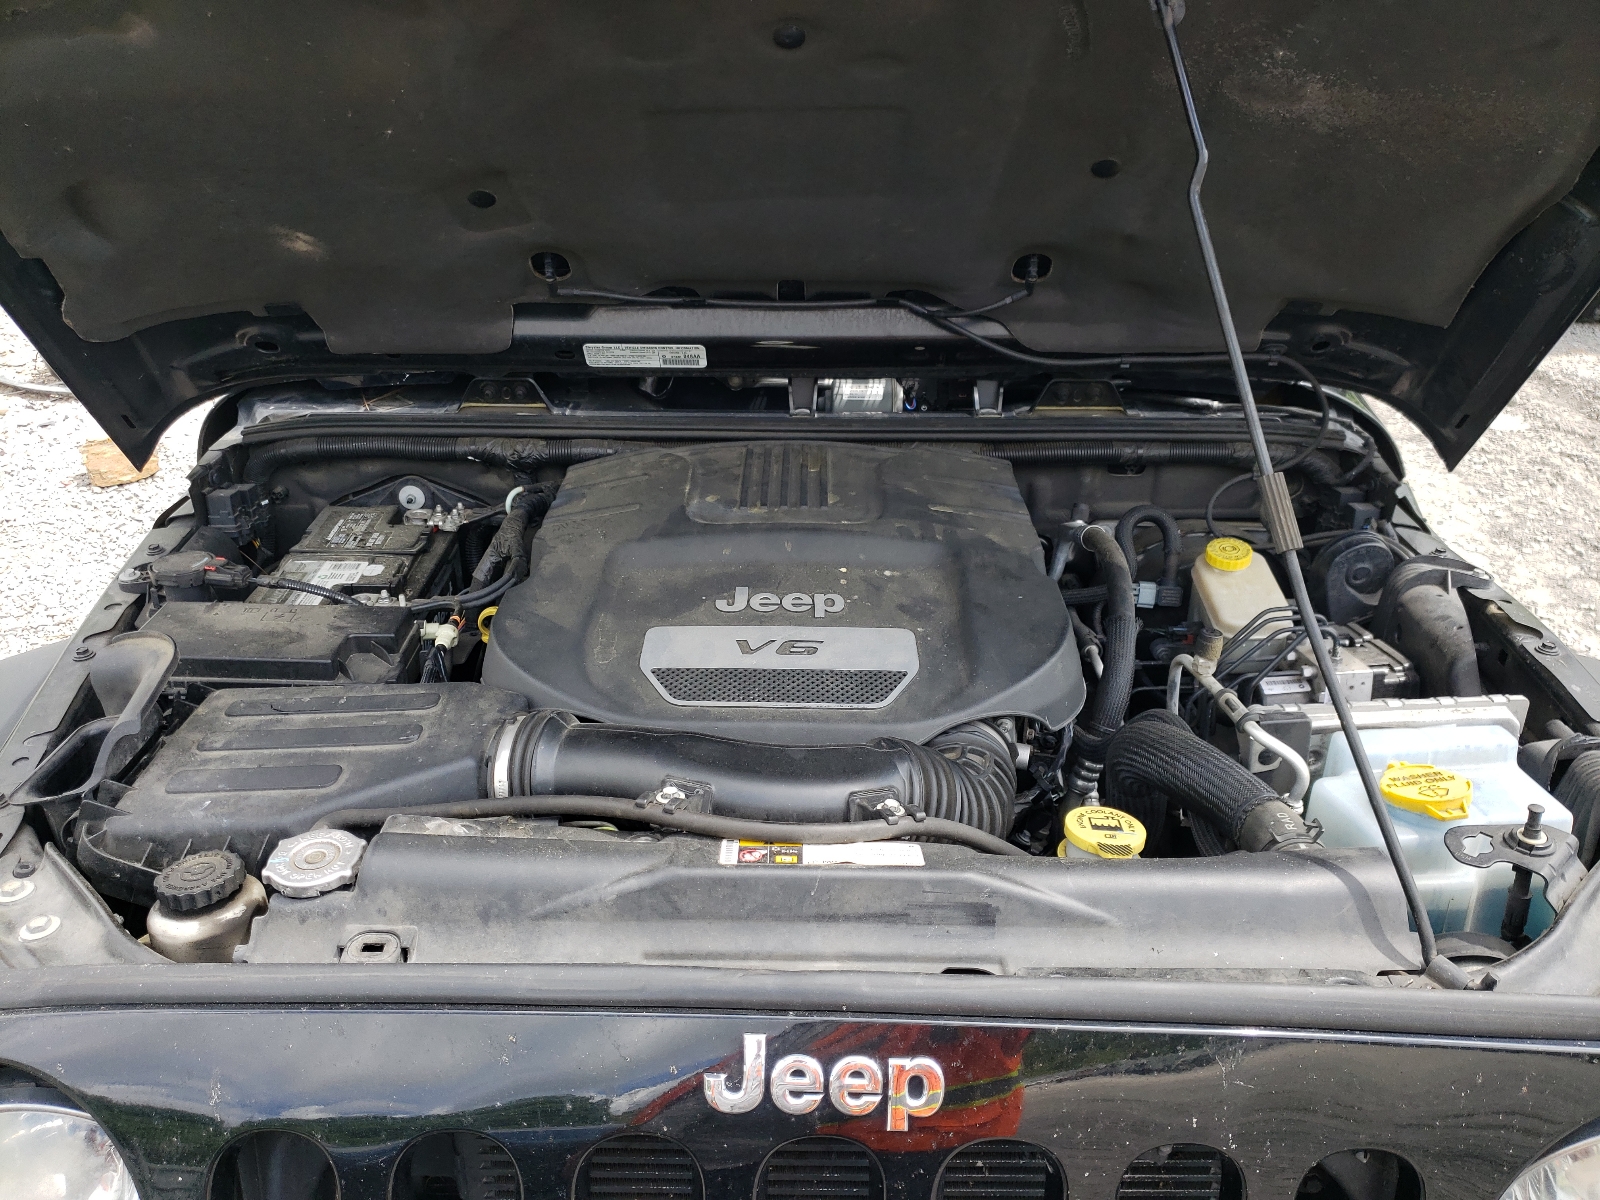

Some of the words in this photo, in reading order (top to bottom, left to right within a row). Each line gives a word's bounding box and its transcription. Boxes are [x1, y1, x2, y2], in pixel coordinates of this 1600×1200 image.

[715, 586, 845, 619] Jeep
[735, 639, 825, 656] V6
[1386, 780, 1422, 789] FLUID
[1424, 775, 1456, 784] ONLY
[1388, 771, 1443, 783] WASHER
[1085, 809, 1126, 820] COOLANT
[1276, 812, 1298, 831] RAD
[703, 1032, 946, 1132] Jeep
